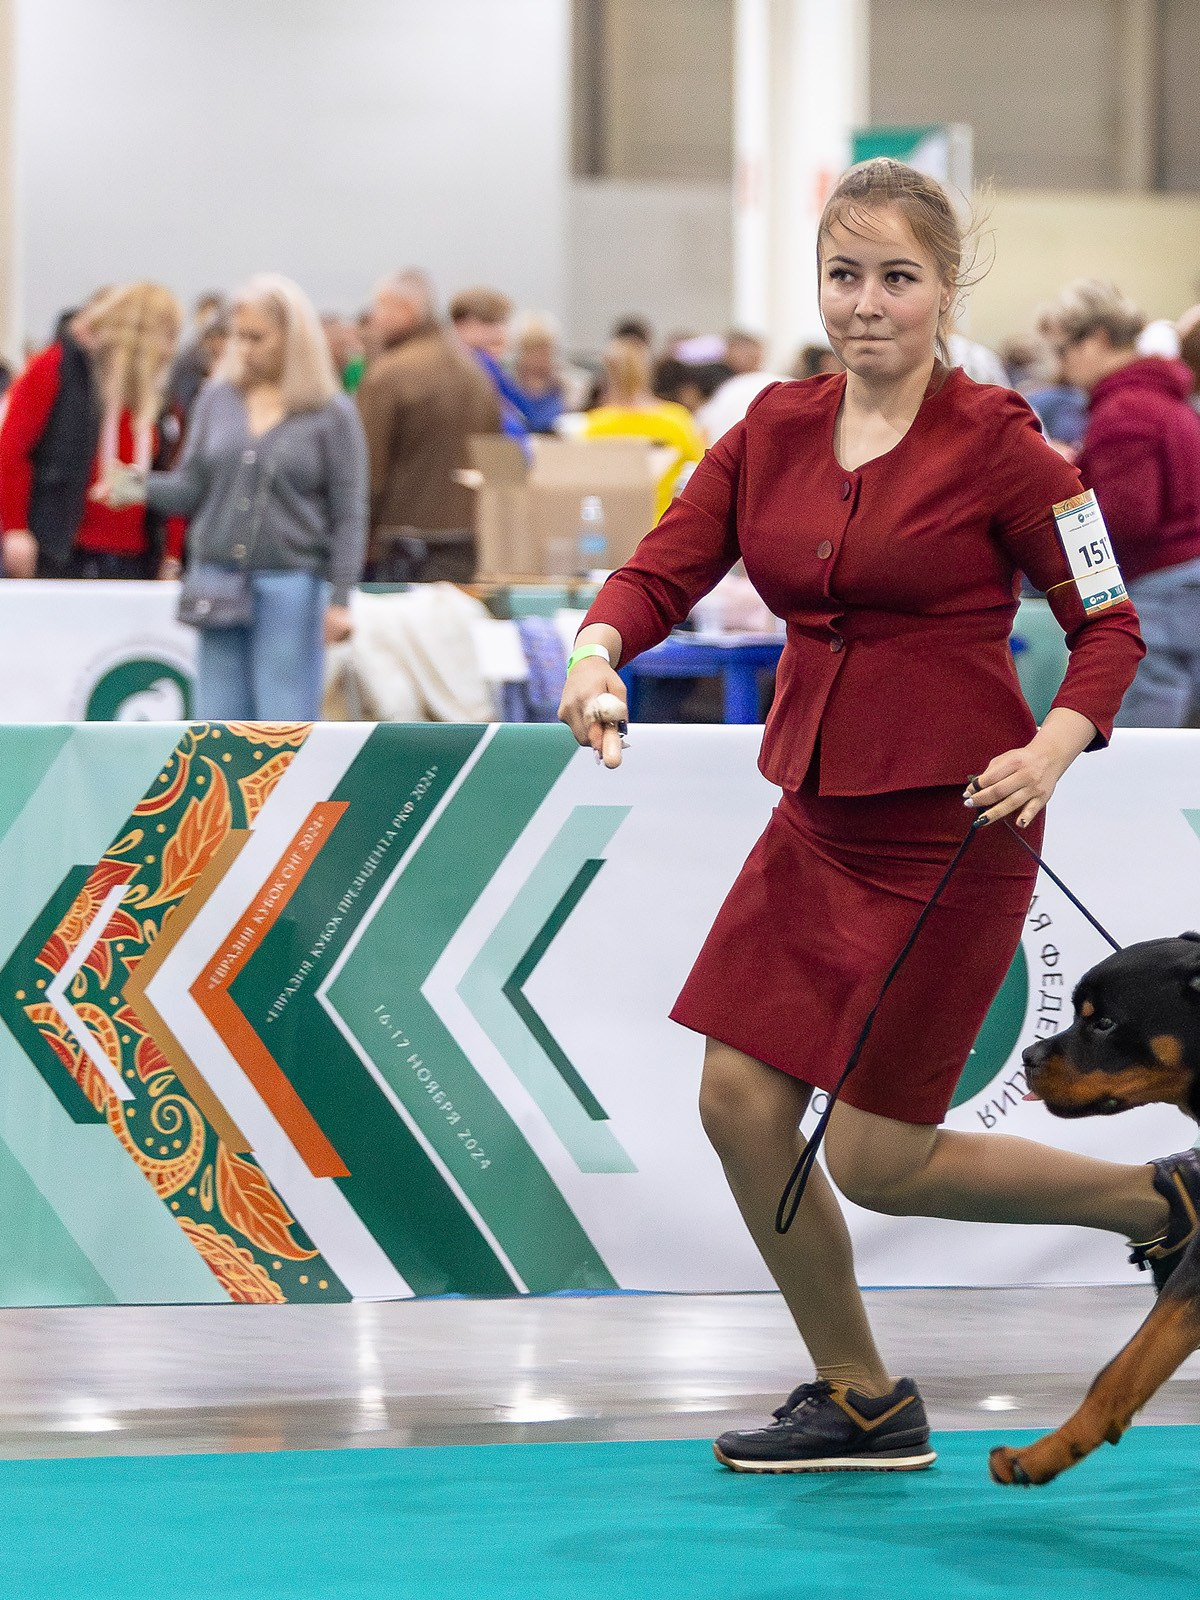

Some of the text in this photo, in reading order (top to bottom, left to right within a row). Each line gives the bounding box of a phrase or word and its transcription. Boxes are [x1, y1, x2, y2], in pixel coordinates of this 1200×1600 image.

[392, 801, 415, 829] РКФ
[976, 943, 1063, 1129] ФЕДЕЦИЯ
[406, 1053, 462, 1126] НОЯБРЯ
[457, 1128, 491, 1170] 2024
